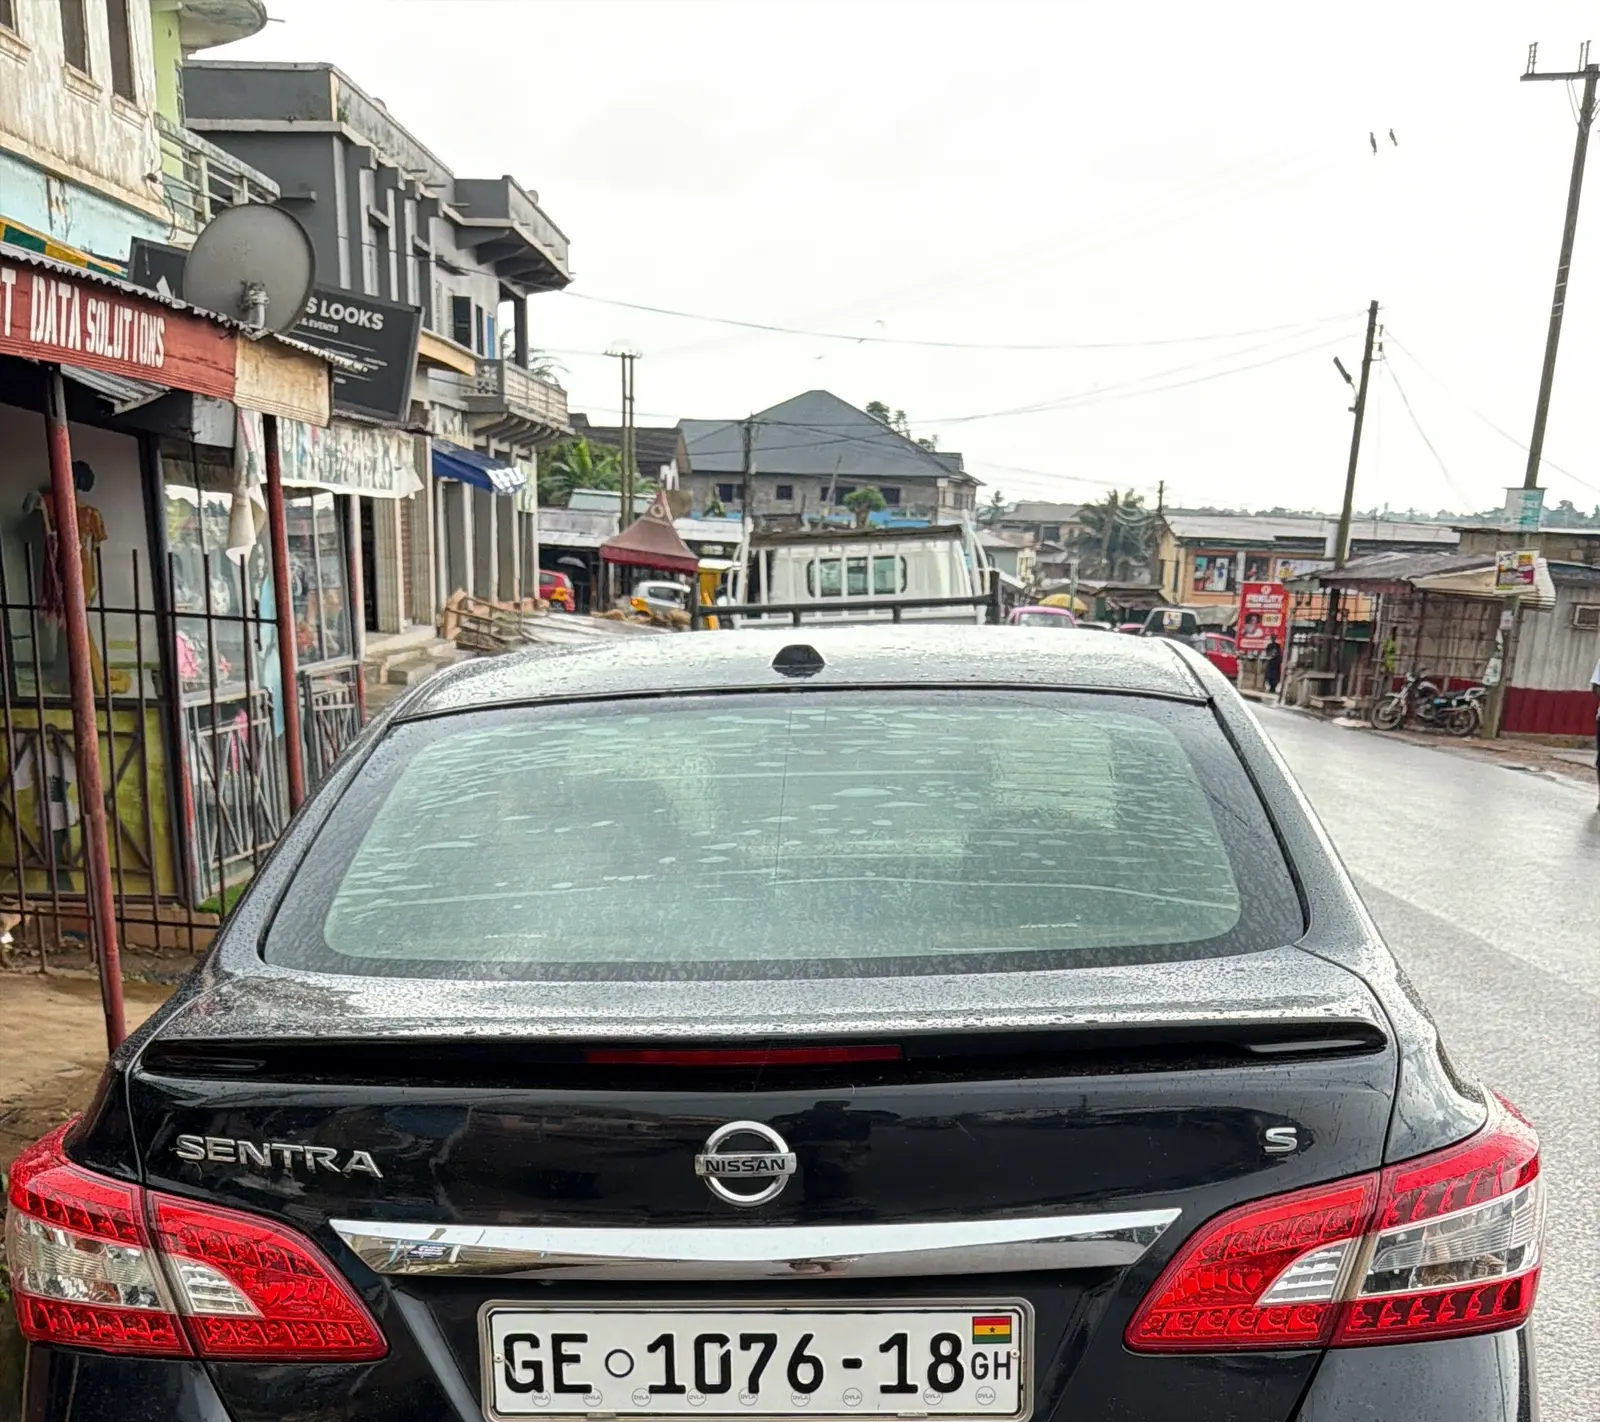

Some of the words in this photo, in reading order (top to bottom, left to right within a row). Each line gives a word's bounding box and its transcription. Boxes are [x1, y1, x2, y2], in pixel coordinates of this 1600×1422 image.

[30, 274, 81, 350] DATA
[85, 298, 165, 368] SOLUTIONS
[309, 319, 339, 334] EVENTS
[320, 300, 384, 330] LOOKS
[1263, 1127, 1297, 1153] S
[175, 1134, 383, 1179] SENTRA
[705, 1158, 785, 1173] NISSAN
[504, 1332, 593, 1394] GE
[971, 1351, 1011, 1381] GH
